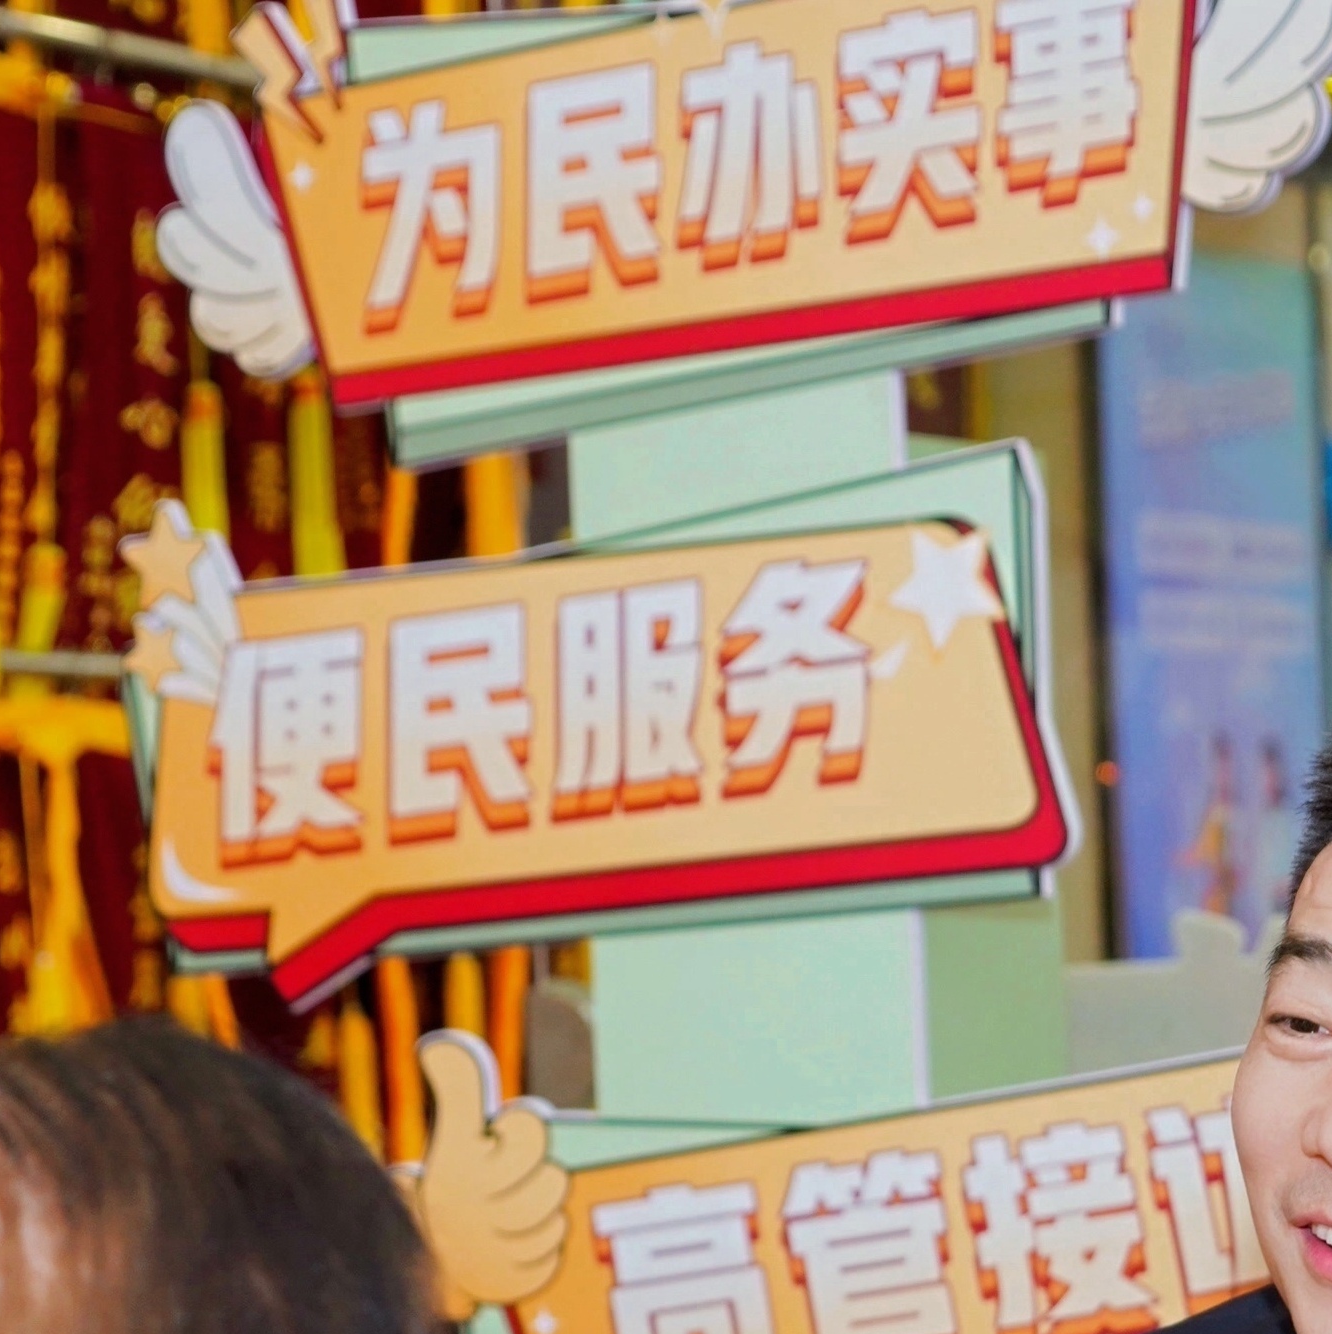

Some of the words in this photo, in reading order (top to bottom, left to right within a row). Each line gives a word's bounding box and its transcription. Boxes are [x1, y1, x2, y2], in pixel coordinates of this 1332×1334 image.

[358, 0, 1142, 335] 为民办实事
[208, 557, 872, 871] 便民服务
